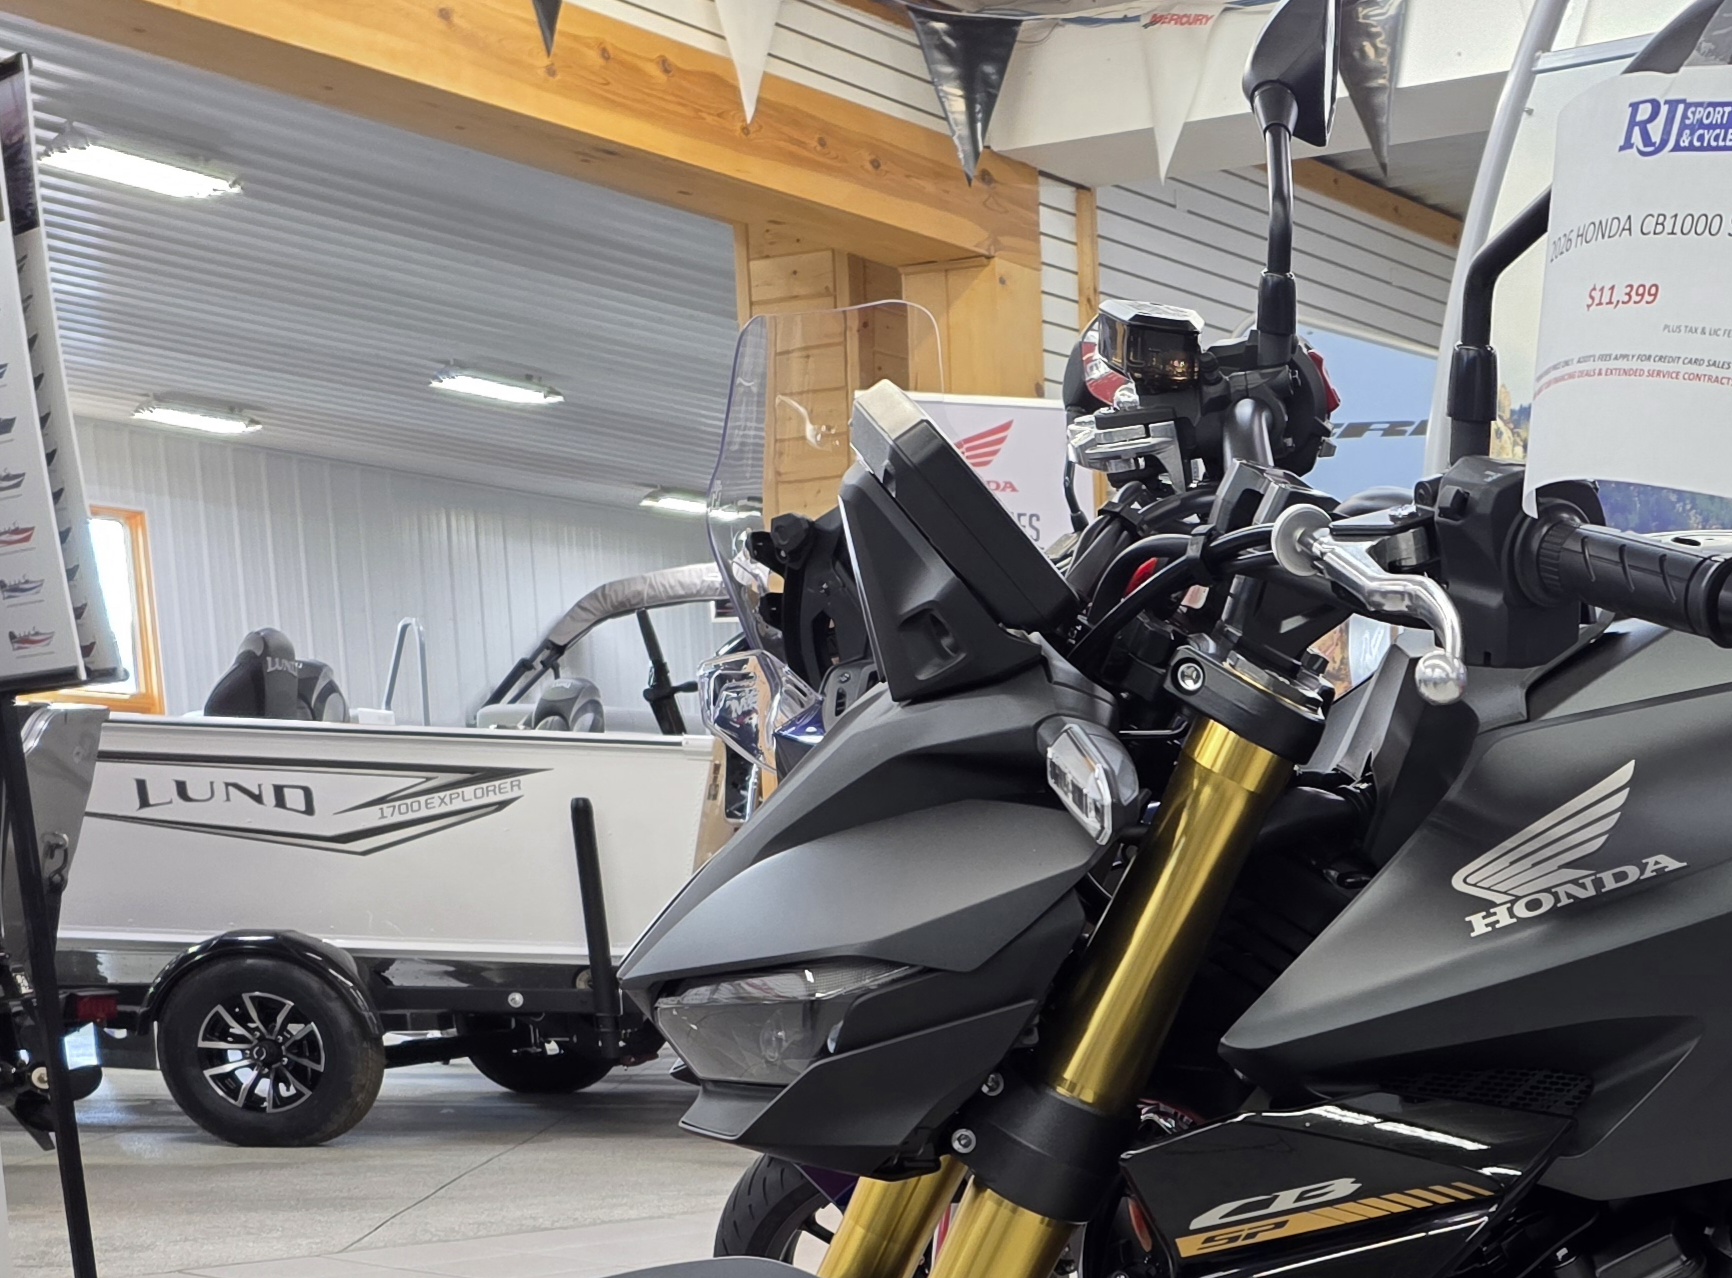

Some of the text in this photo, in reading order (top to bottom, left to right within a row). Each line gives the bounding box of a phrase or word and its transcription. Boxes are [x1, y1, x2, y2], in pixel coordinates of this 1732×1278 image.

[1150, 13, 1215, 26] MERCURY
[1618, 98, 1687, 157] RJ
[1685, 106, 1732, 124] SPORT
[1679, 129, 1690, 147] &
[1550, 230, 1574, 263] 2026
[1575, 214, 1633, 249] HONDA
[1639, 213, 1724, 237] CB1000
[1586, 283, 1660, 311] $11,399
[1663, 324, 1682, 334] PLUS
[1683, 325, 1699, 335] TAX
[1700, 326, 1707, 336] &
[1709, 326, 1721, 338] LIC
[1597, 353, 1612, 362] FEES
[1613, 353, 1636, 362] APPLY
[1636, 354, 1651, 362] FOR
[1653, 355, 1681, 365] CREDIT
[1682, 356, 1704, 367] CARD
[1605, 367, 1645, 377] EXTENDED
[1646, 369, 1680, 380] SERVICE
[134, 778, 316, 817] LUND
[377, 779, 522, 821] 1700 EXPLORER
[1464, 854, 1688, 938] HONDA
[1189, 1178, 1362, 1230] CB
[1197, 1220, 1289, 1251] SP
